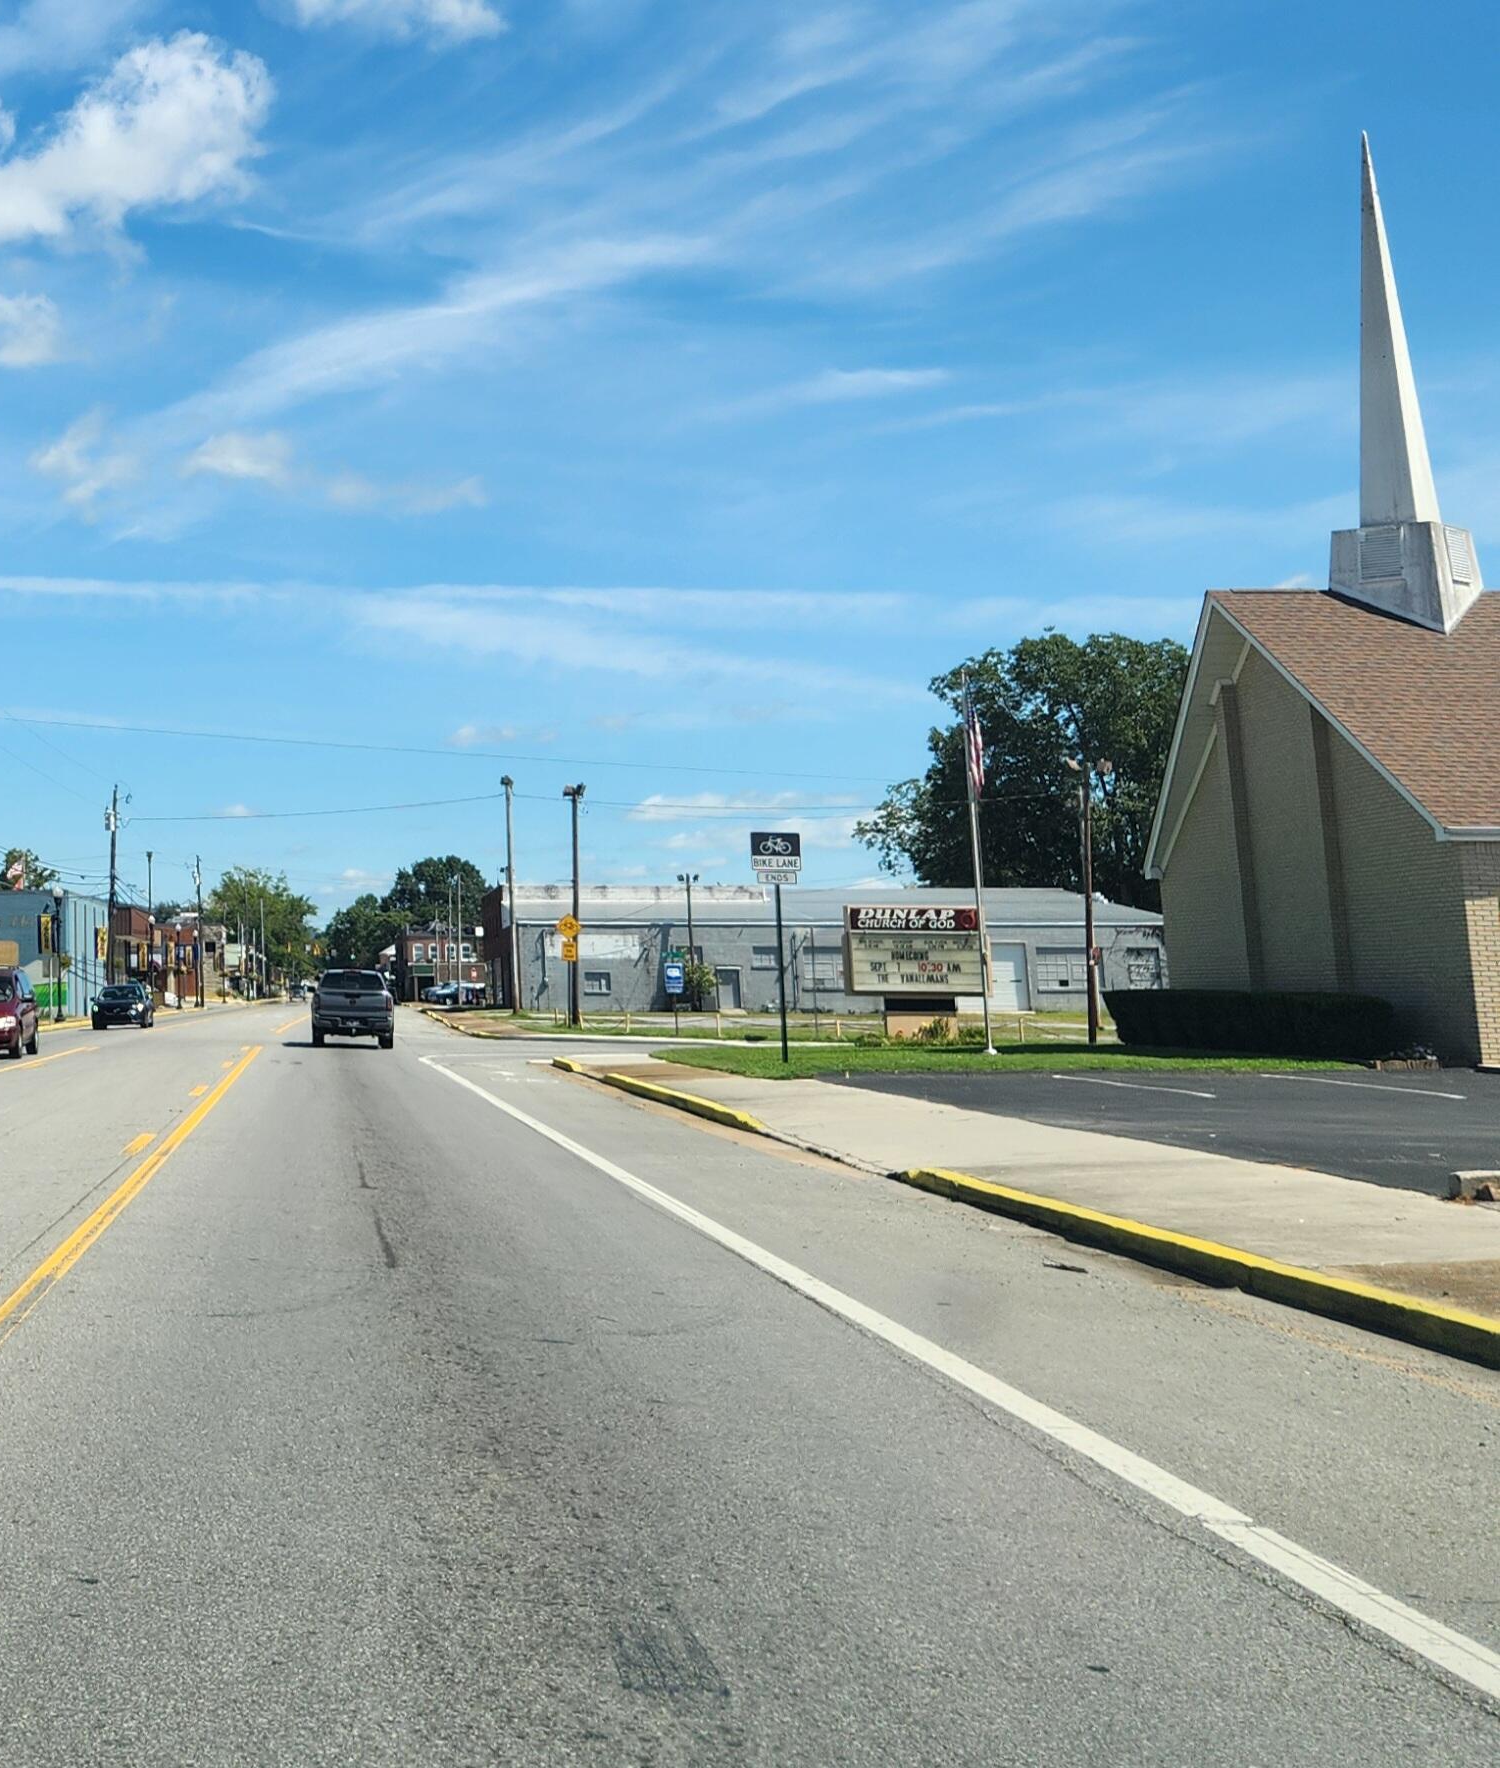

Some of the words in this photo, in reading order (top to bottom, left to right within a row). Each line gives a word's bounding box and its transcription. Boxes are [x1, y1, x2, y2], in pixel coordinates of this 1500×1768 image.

[753, 858, 773, 867] BIKE
[776, 858, 799, 868] LANE
[765, 874, 789, 882] ENDS
[858, 909, 955, 920] DUNLAP
[857, 919, 906, 928] CHURCH
[908, 919, 924, 929] OF
[928, 920, 956, 929] GOD
[918, 962, 944, 972] 10:30
[946, 962, 961, 972] AM
[877, 973, 889, 983] THE
